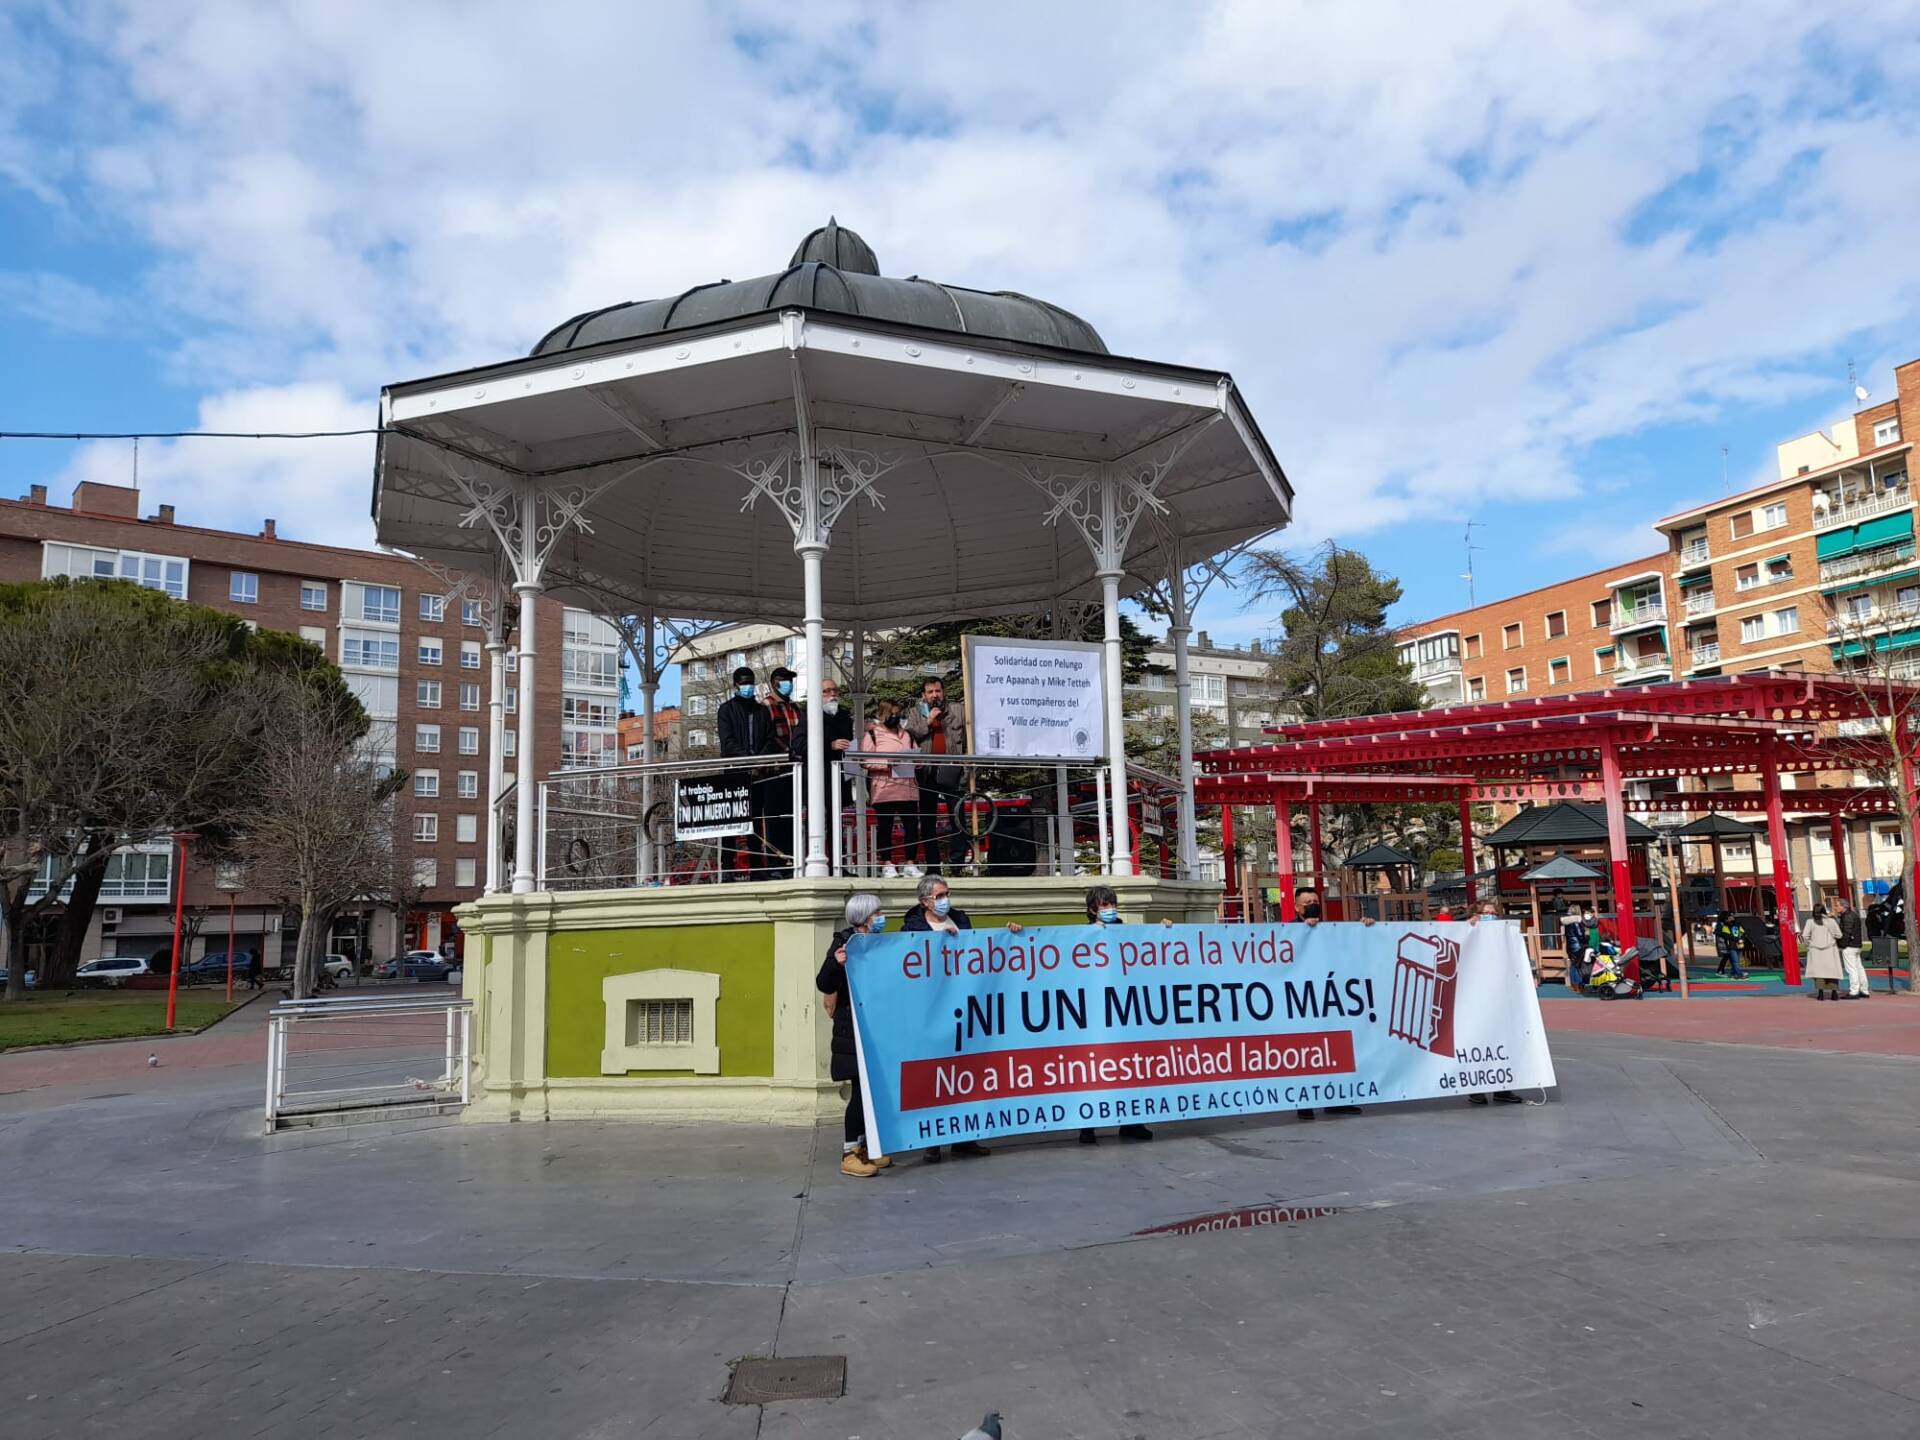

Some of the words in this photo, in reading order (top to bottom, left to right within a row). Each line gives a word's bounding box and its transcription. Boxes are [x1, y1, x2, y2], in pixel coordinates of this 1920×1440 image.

[994, 656, 1037, 667] Solidaridad
[1039, 659, 1053, 668] con
[1054, 658, 1083, 671] Pelungo
[985, 674, 1004, 685] Zure
[1006, 675, 1040, 688] Apaanah
[1041, 677, 1046, 687] y
[1048, 677, 1066, 687] Mike
[1068, 677, 1091, 688] Tetteh
[1000, 697, 1005, 707] y
[1007, 697, 1020, 706] sus
[1021, 697, 1066, 708] compañeros
[1067, 699, 1079, 708] del
[1029, 717, 1039, 726] de
[680, 786, 687, 796] el
[688, 784, 713, 796] trabajo
[697, 793, 705, 802] es
[706, 791, 723, 803] para
[725, 788, 732, 799] la
[733, 786, 749, 798] vida
[692, 805, 703, 822] UN
[704, 802, 731, 820] MUERTO
[903, 939, 932, 980] el
[941, 936, 1061, 981] trabajo
[1071, 943, 1109, 969] es
[1119, 939, 1188, 976] para
[1199, 930, 1222, 965] la
[1231, 930, 1295, 965] vida
[953, 992, 1006, 1052] ¡NI
[1021, 988, 1088, 1034] UN
[1104, 981, 1274, 1028] MUERTO
[1284, 971, 1378, 1023] MÁS!
[1457, 1045, 1510, 1064] H.O.A.C.
[935, 1064, 976, 1099] No
[982, 1070, 999, 1092] a
[1008, 1055, 1034, 1090] la
[1043, 1041, 1232, 1087] siniestralidad
[1240, 1037, 1337, 1073] laboral.
[1439, 1072, 1457, 1090] de
[1459, 1067, 1514, 1088] BURGOS
[919, 1104, 1066, 1139] HERMANDAD
[1079, 1096, 1169, 1120] OBRERA
[1177, 1093, 1201, 1112] DE
[1207, 1085, 1279, 1110] ACCIÓN
[1284, 1080, 1379, 1105] CATÓLICA
